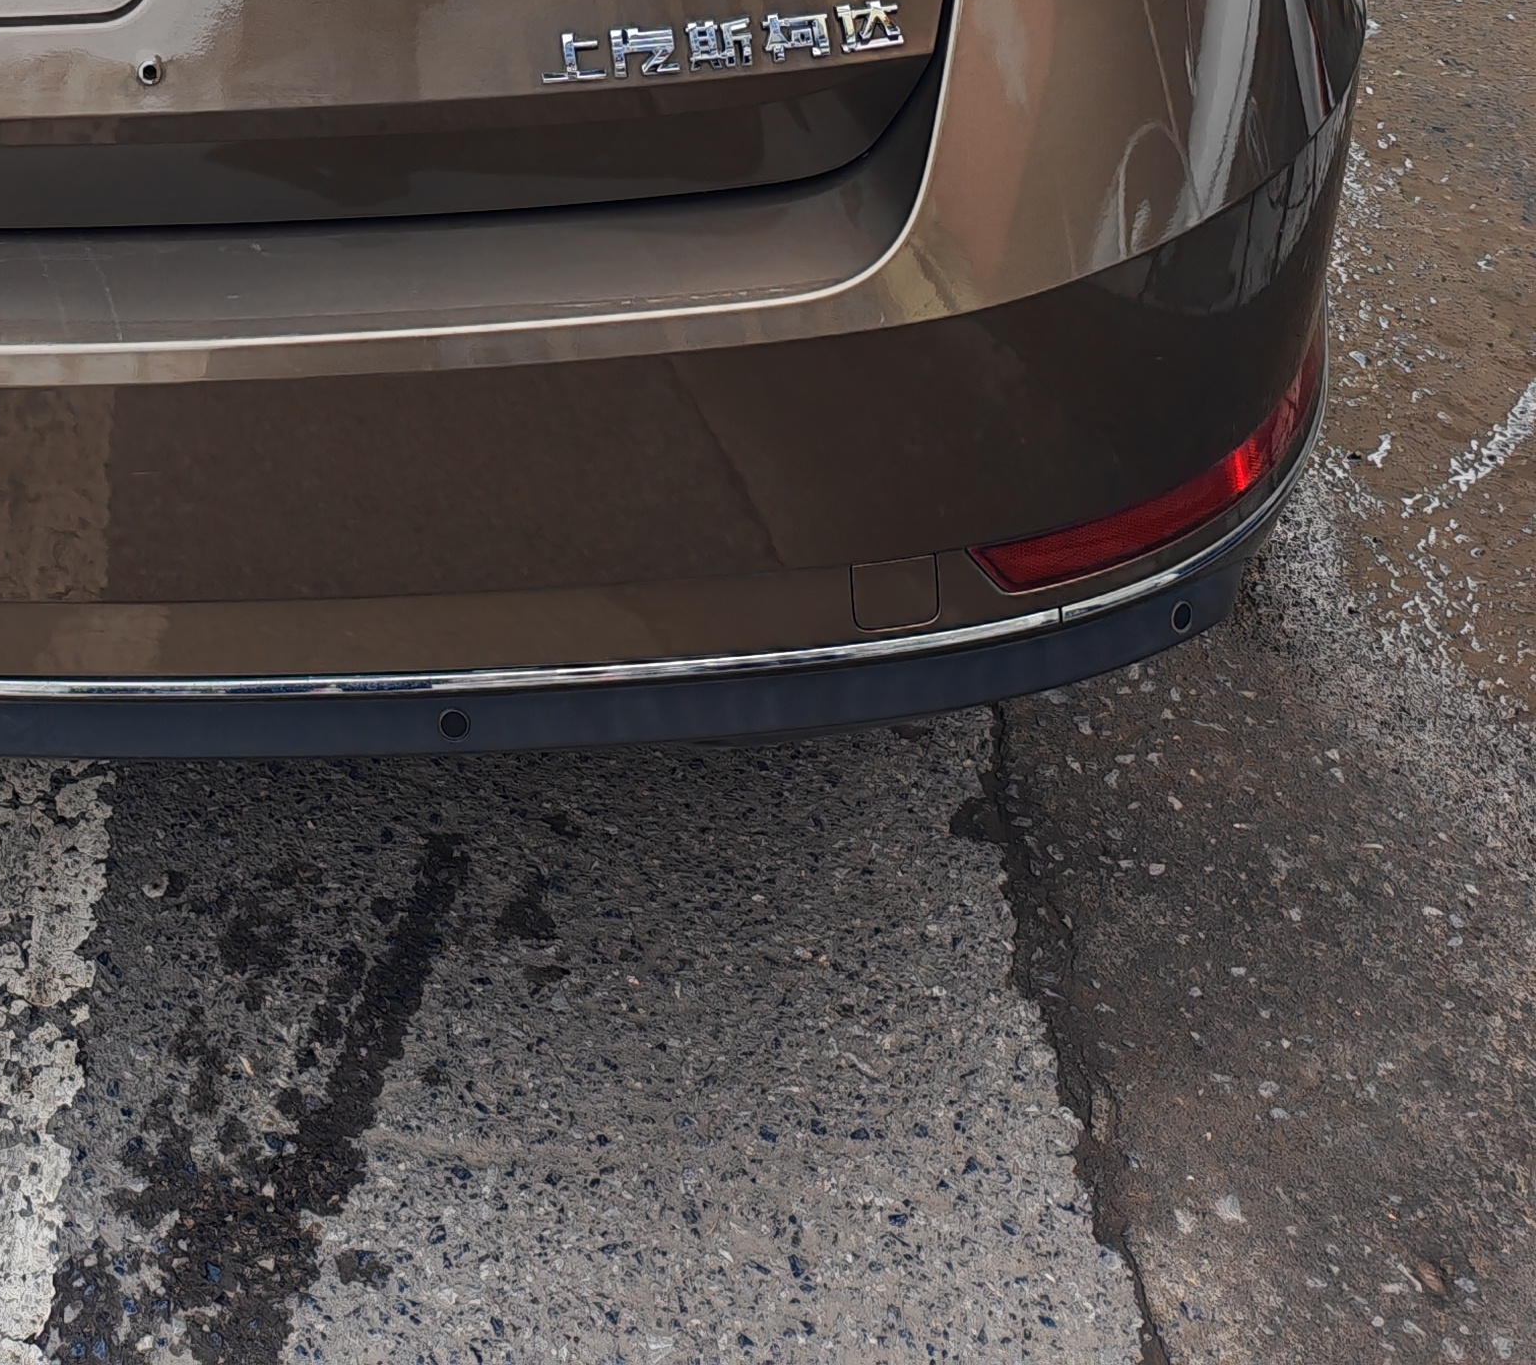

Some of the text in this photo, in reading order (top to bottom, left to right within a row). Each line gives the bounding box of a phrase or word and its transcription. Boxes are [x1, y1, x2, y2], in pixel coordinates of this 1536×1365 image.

[540, 0, 906, 86] 上汽斯柯达
